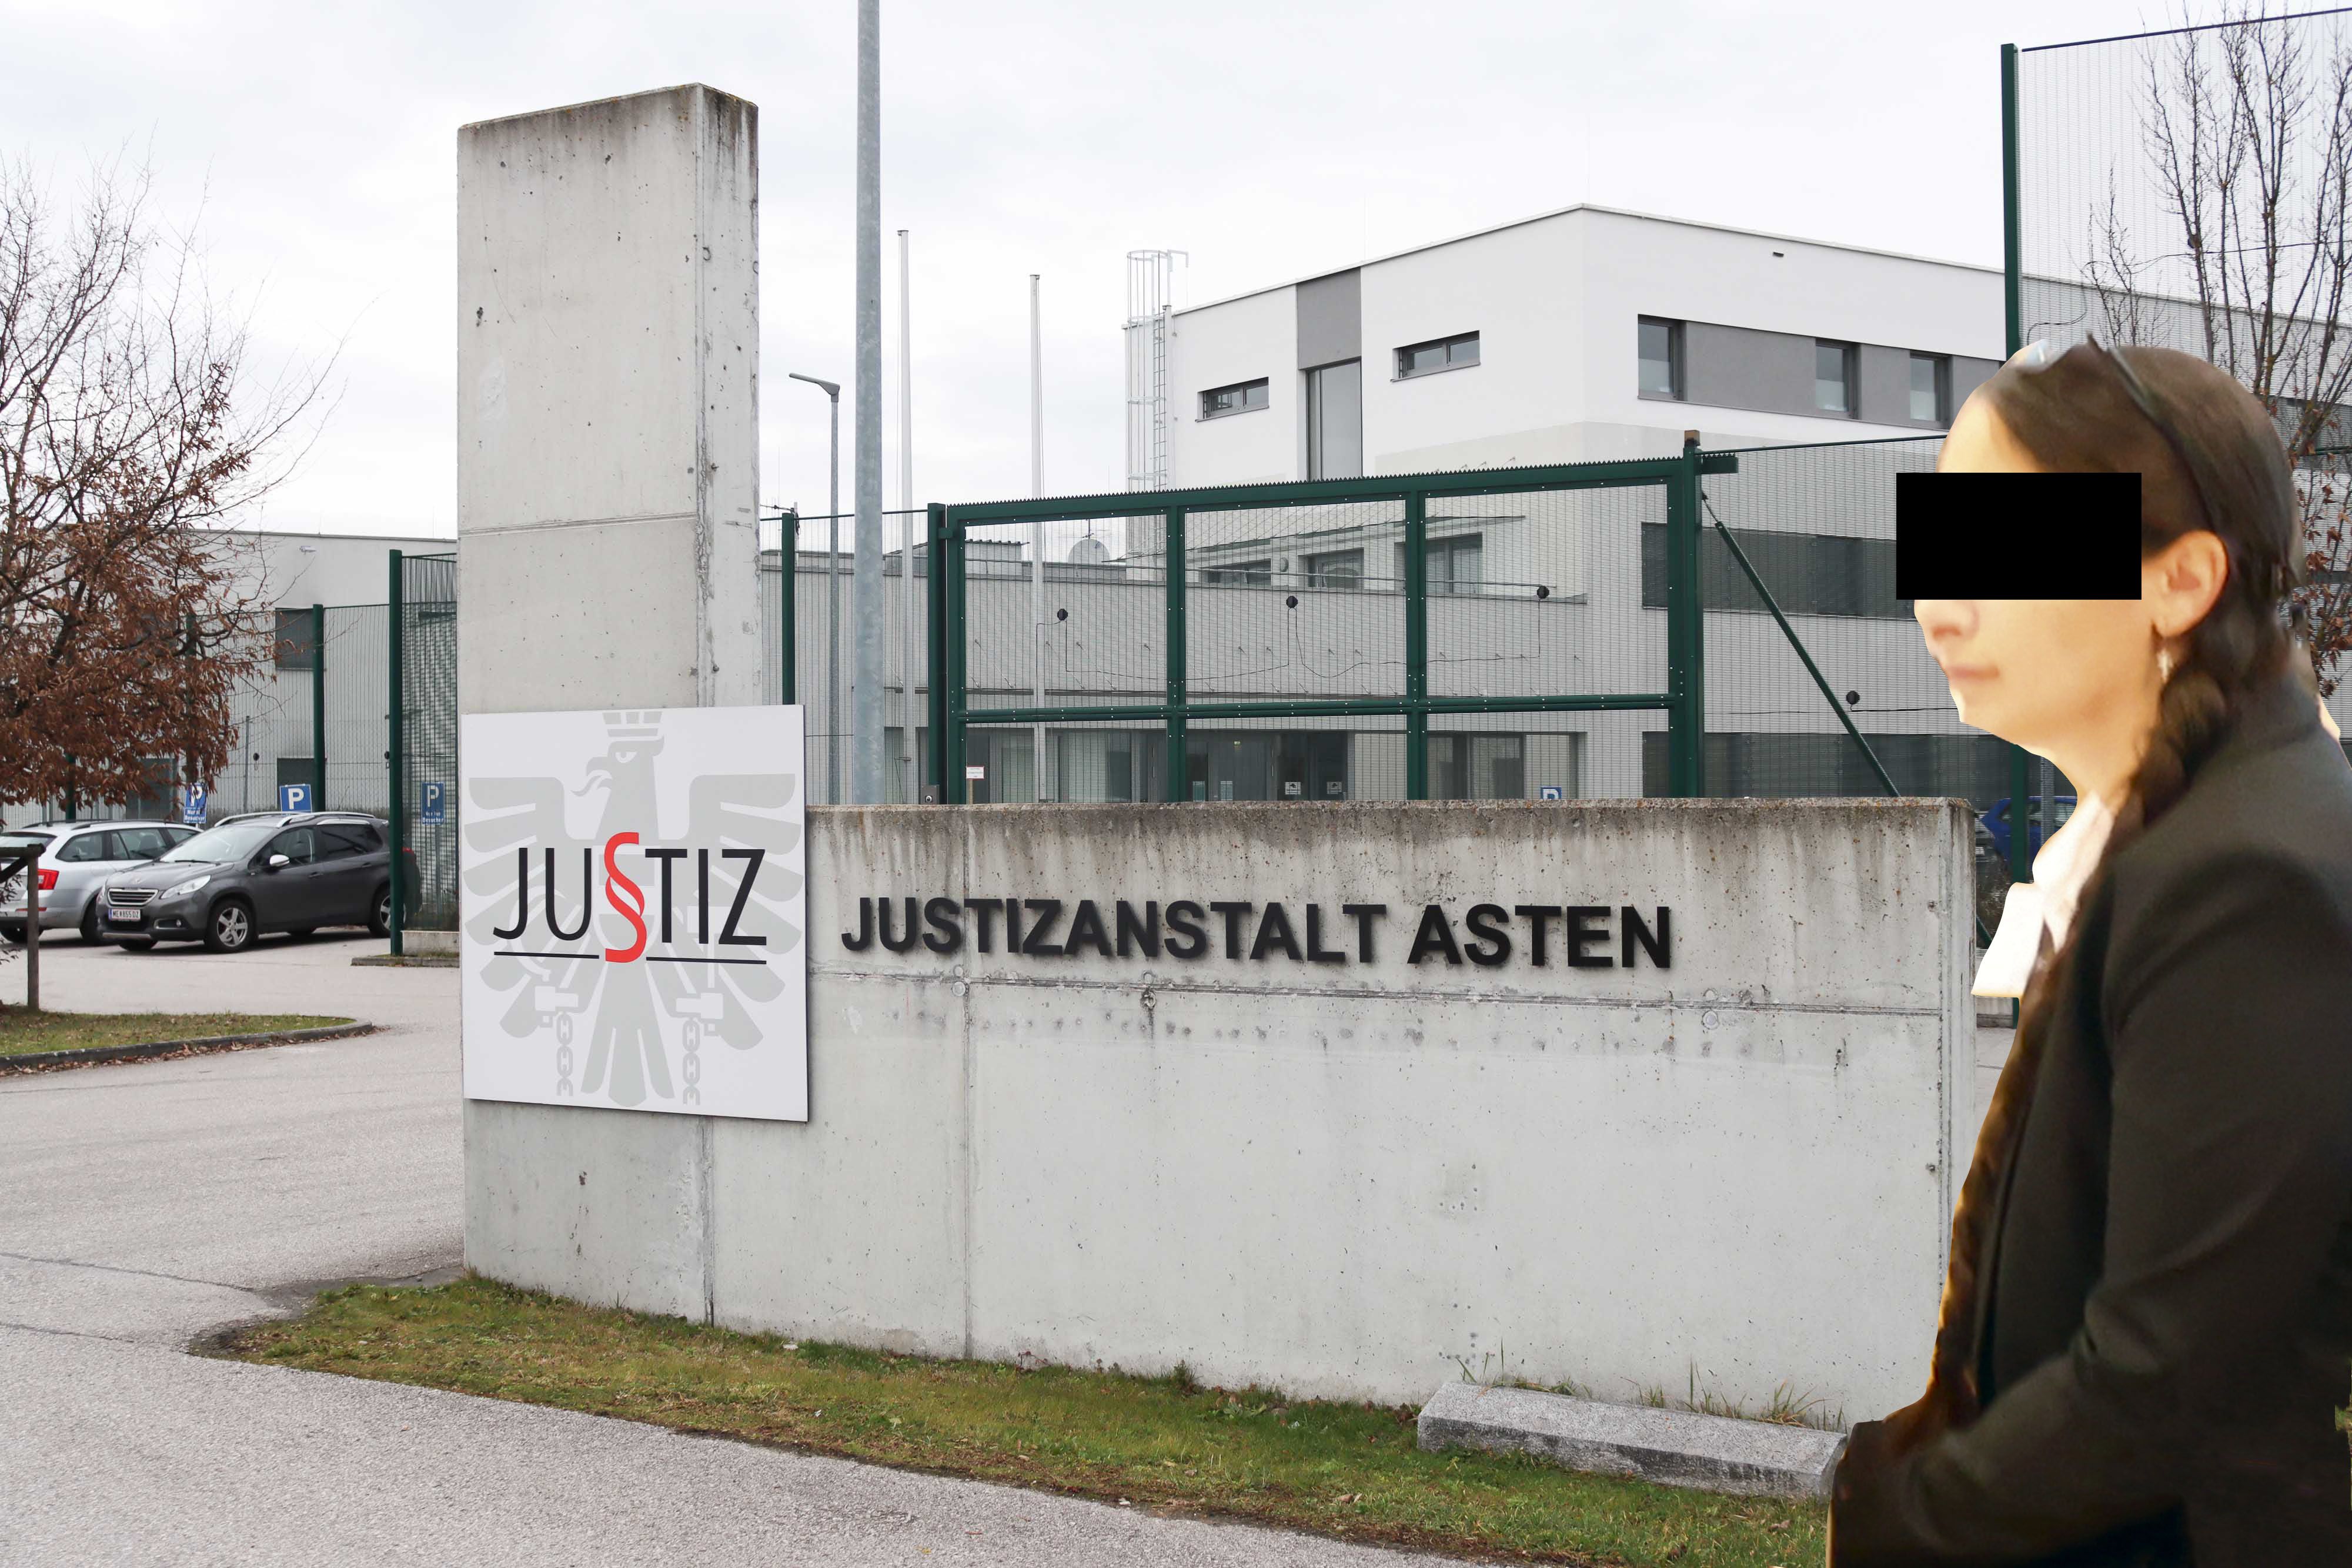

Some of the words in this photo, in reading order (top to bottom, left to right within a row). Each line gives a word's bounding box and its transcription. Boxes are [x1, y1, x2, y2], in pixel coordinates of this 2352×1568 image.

[191, 785, 203, 807] P
[288, 788, 305, 810] P
[427, 785, 440, 808] P
[841, 897, 1387, 964] JUSTIZANSTALT
[1407, 904, 1671, 968] ASTEN
